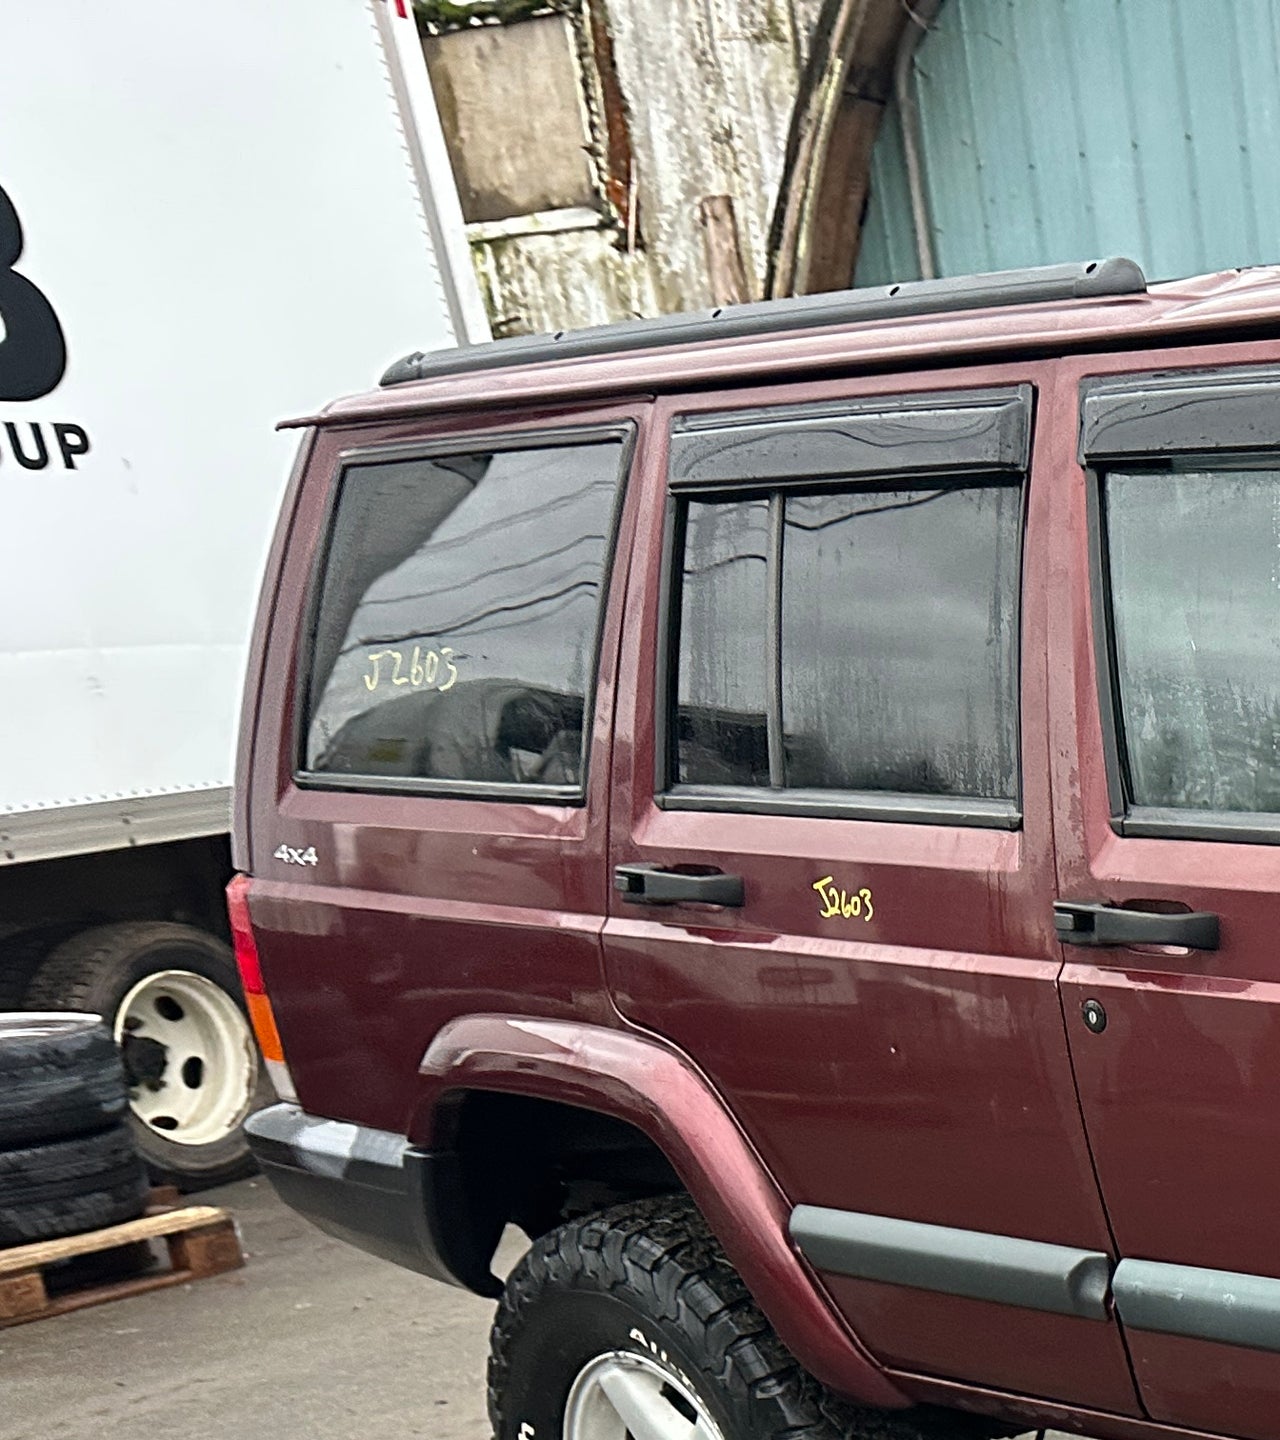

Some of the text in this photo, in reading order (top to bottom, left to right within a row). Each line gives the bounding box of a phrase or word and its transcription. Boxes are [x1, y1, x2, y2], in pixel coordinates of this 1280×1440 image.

[0, 421, 90, 470] UP
[364, 646, 457, 691] J2603
[812, 875, 874, 922] J2603
